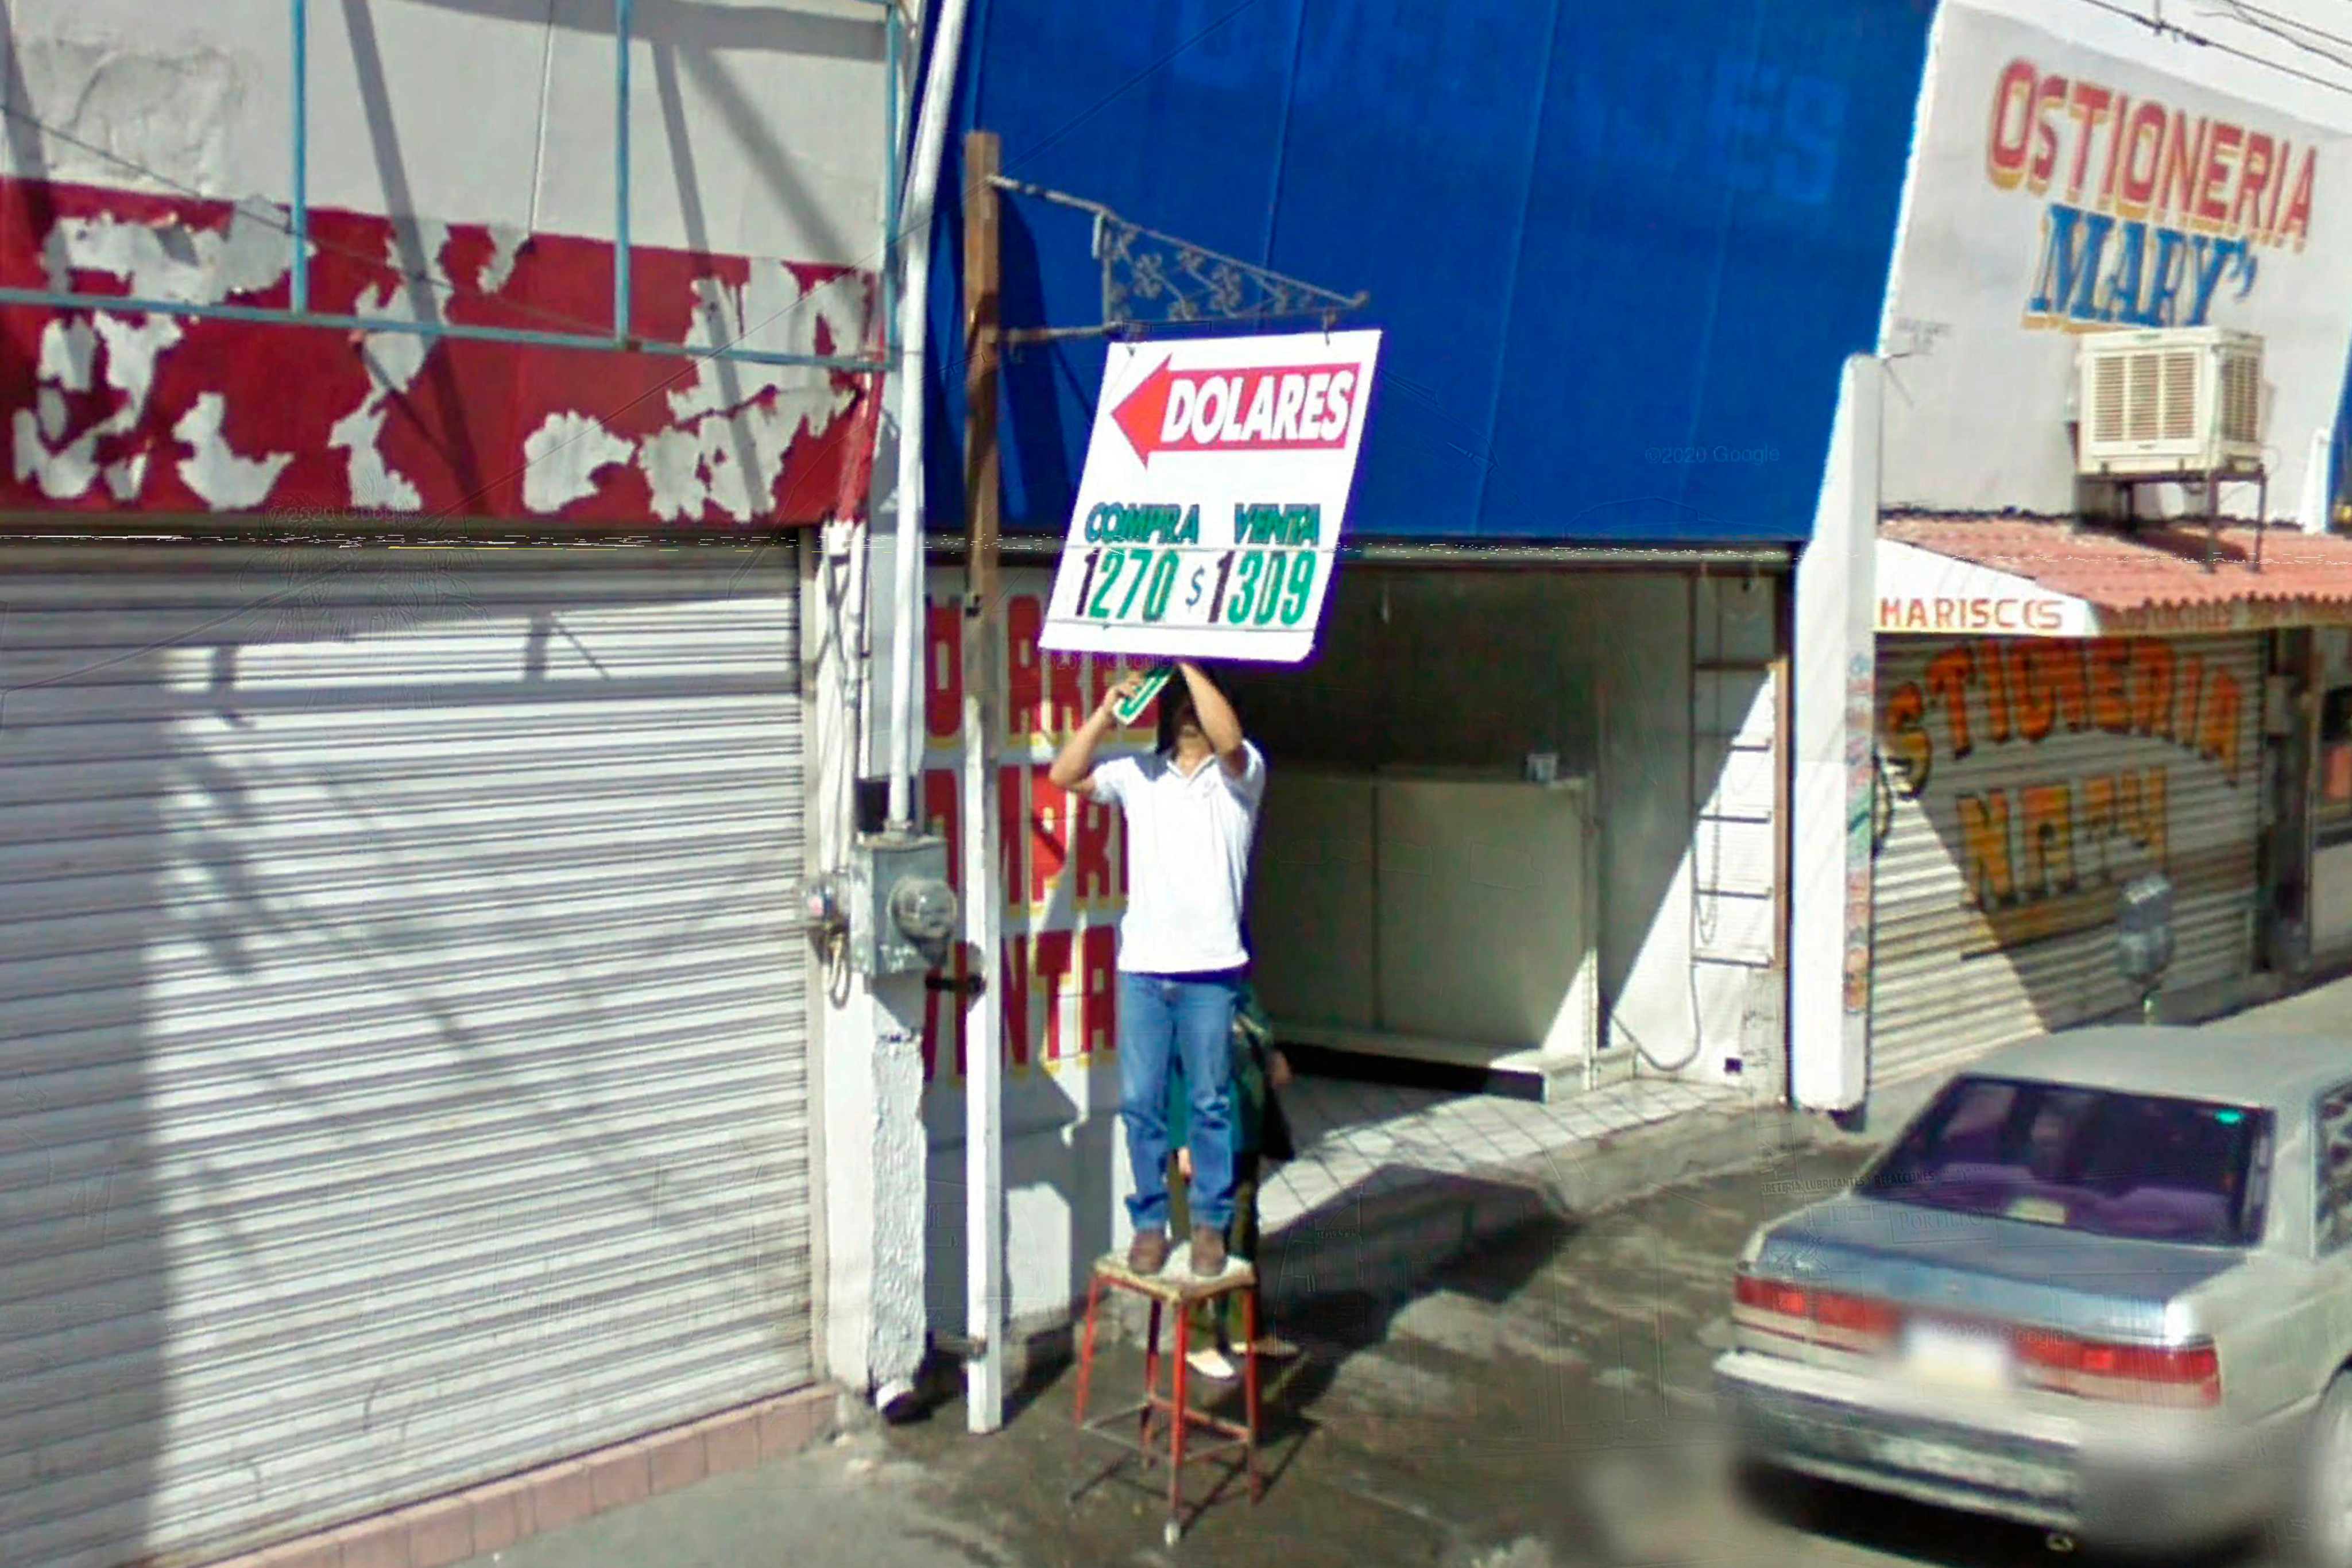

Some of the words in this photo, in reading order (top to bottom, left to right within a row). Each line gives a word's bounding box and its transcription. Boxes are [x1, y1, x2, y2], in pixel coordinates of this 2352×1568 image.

[1987, 56, 2317, 251] OSTIONERIA
[1160, 370, 1355, 444] DOLARES
[1085, 501, 1200, 545] COMPRA
[1234, 502, 1320, 545] VENTA
[1075, 547, 1179, 622] 1270
